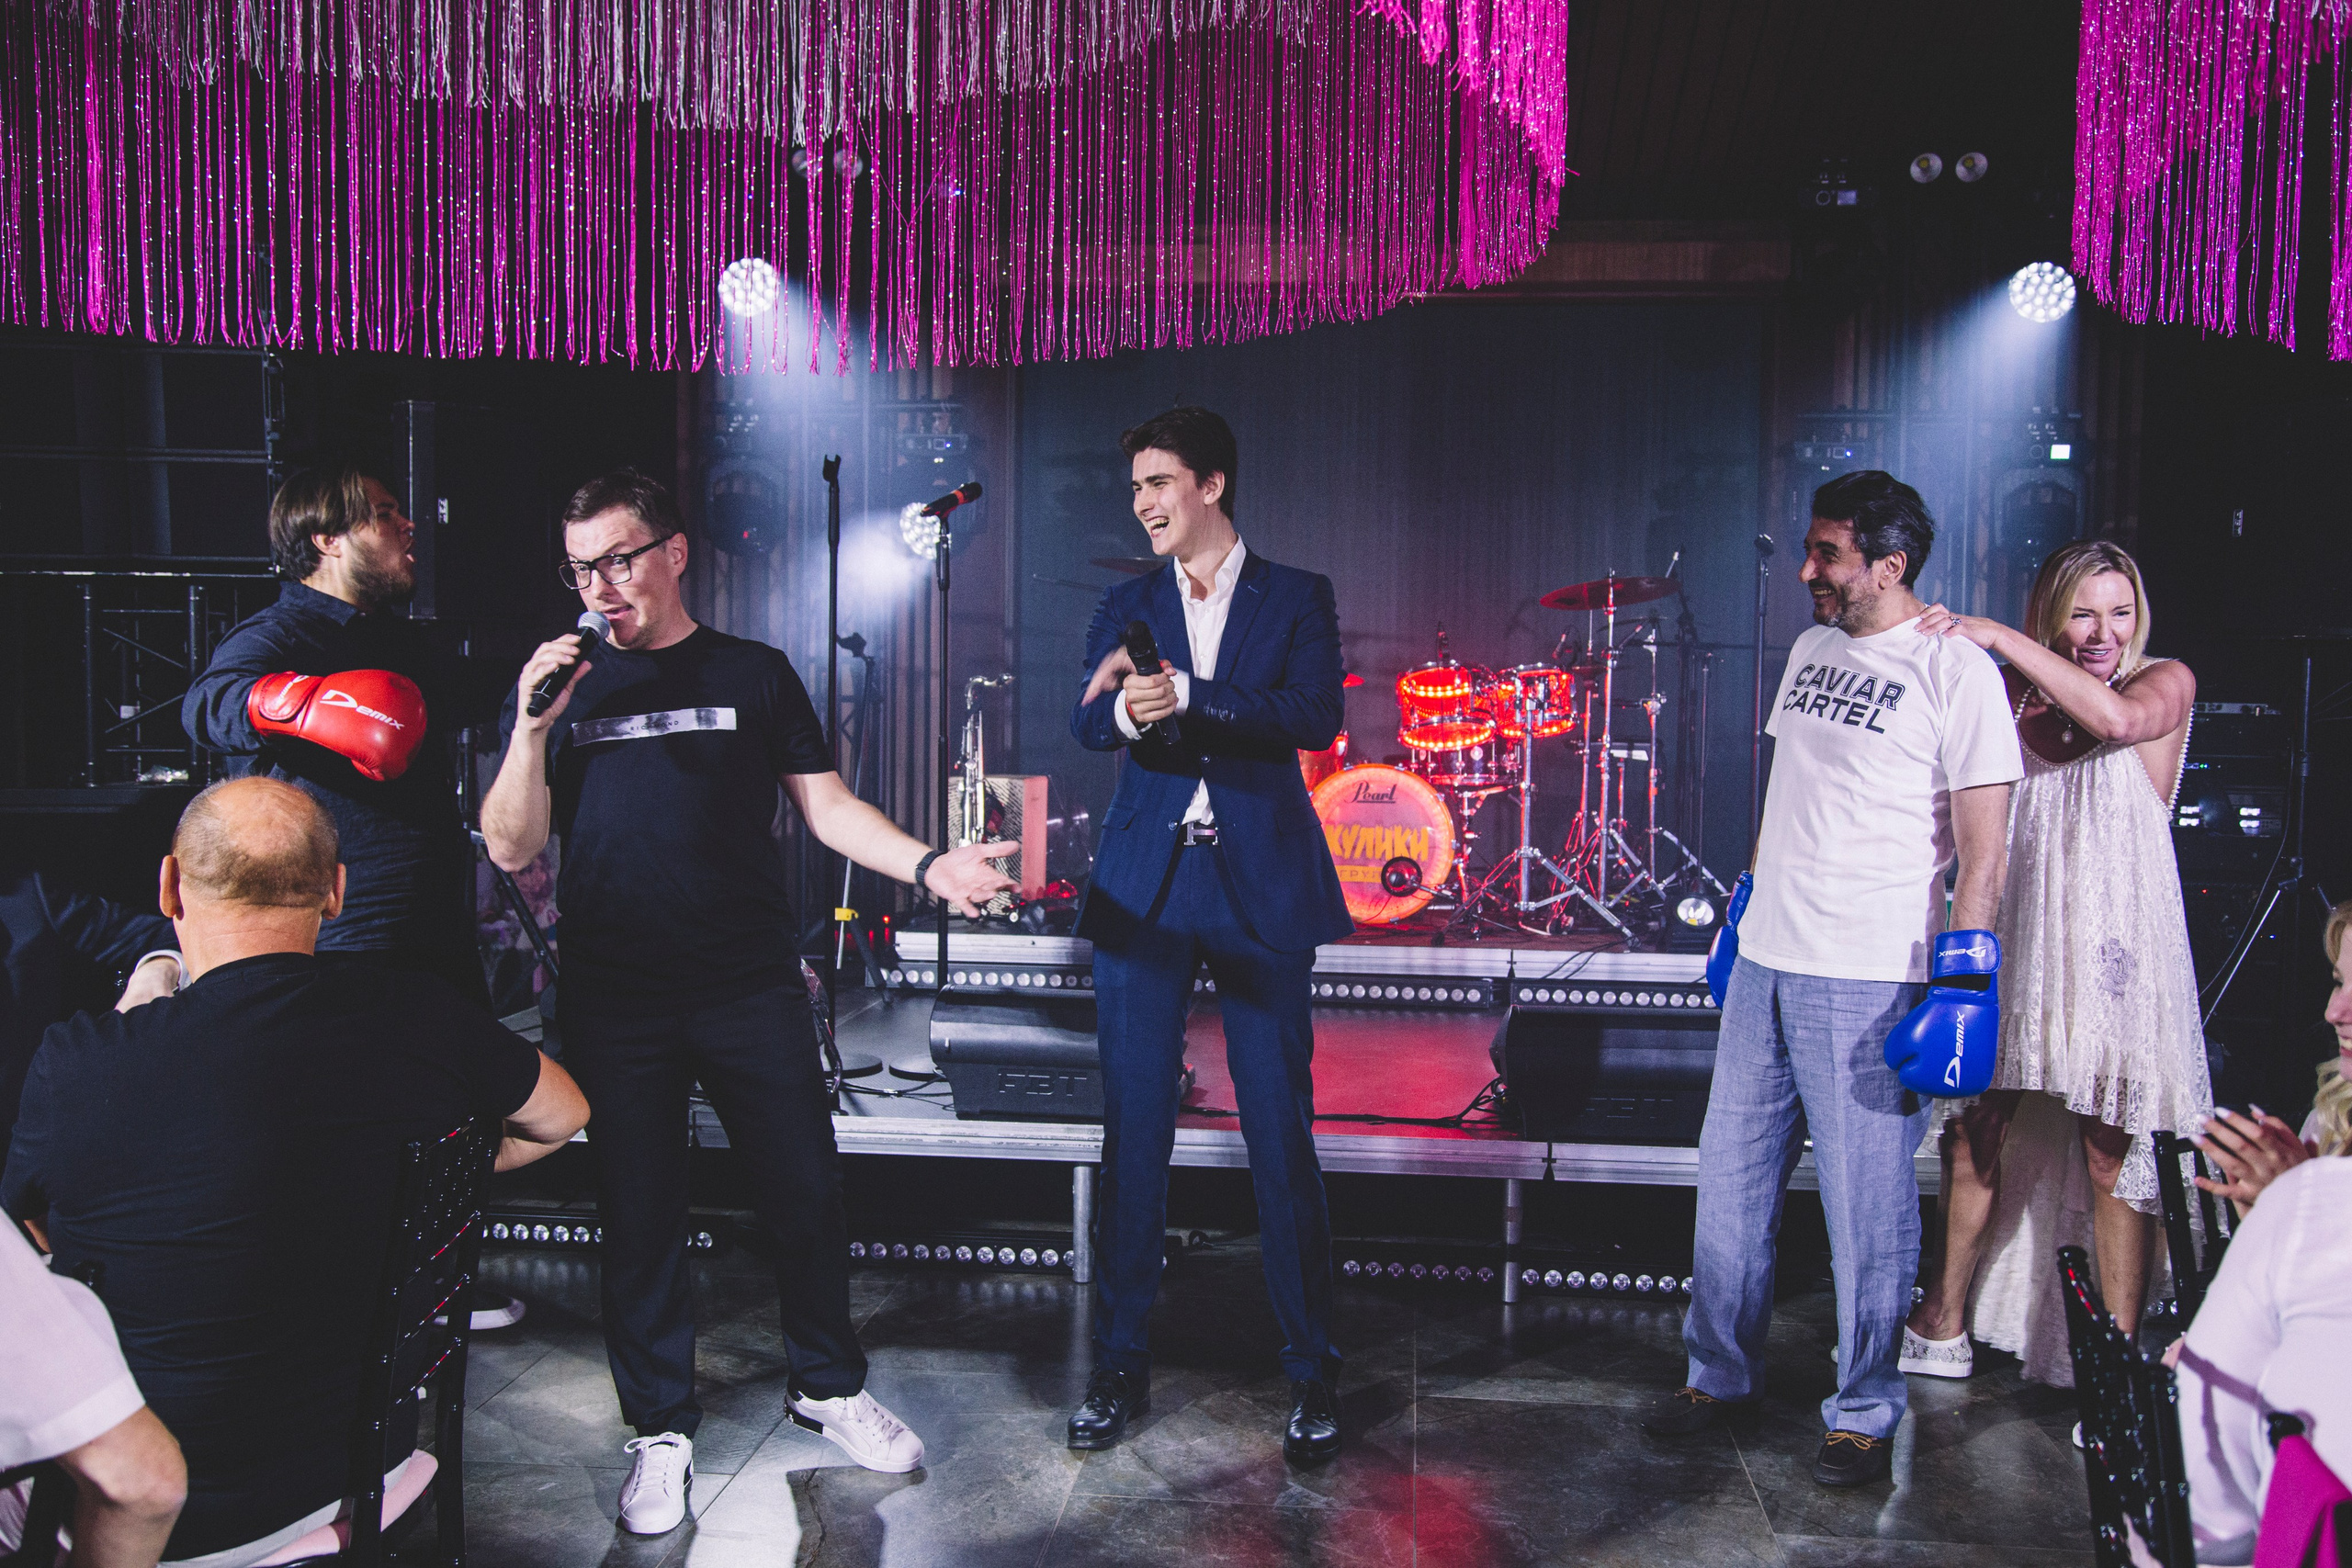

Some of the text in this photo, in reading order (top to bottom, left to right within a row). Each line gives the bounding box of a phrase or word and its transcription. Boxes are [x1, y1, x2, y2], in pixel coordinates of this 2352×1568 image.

[1794, 664, 1905, 711] CAVIAR
[1783, 690, 1885, 734] CARTEL
[1343, 780, 1396, 804] Pearl
